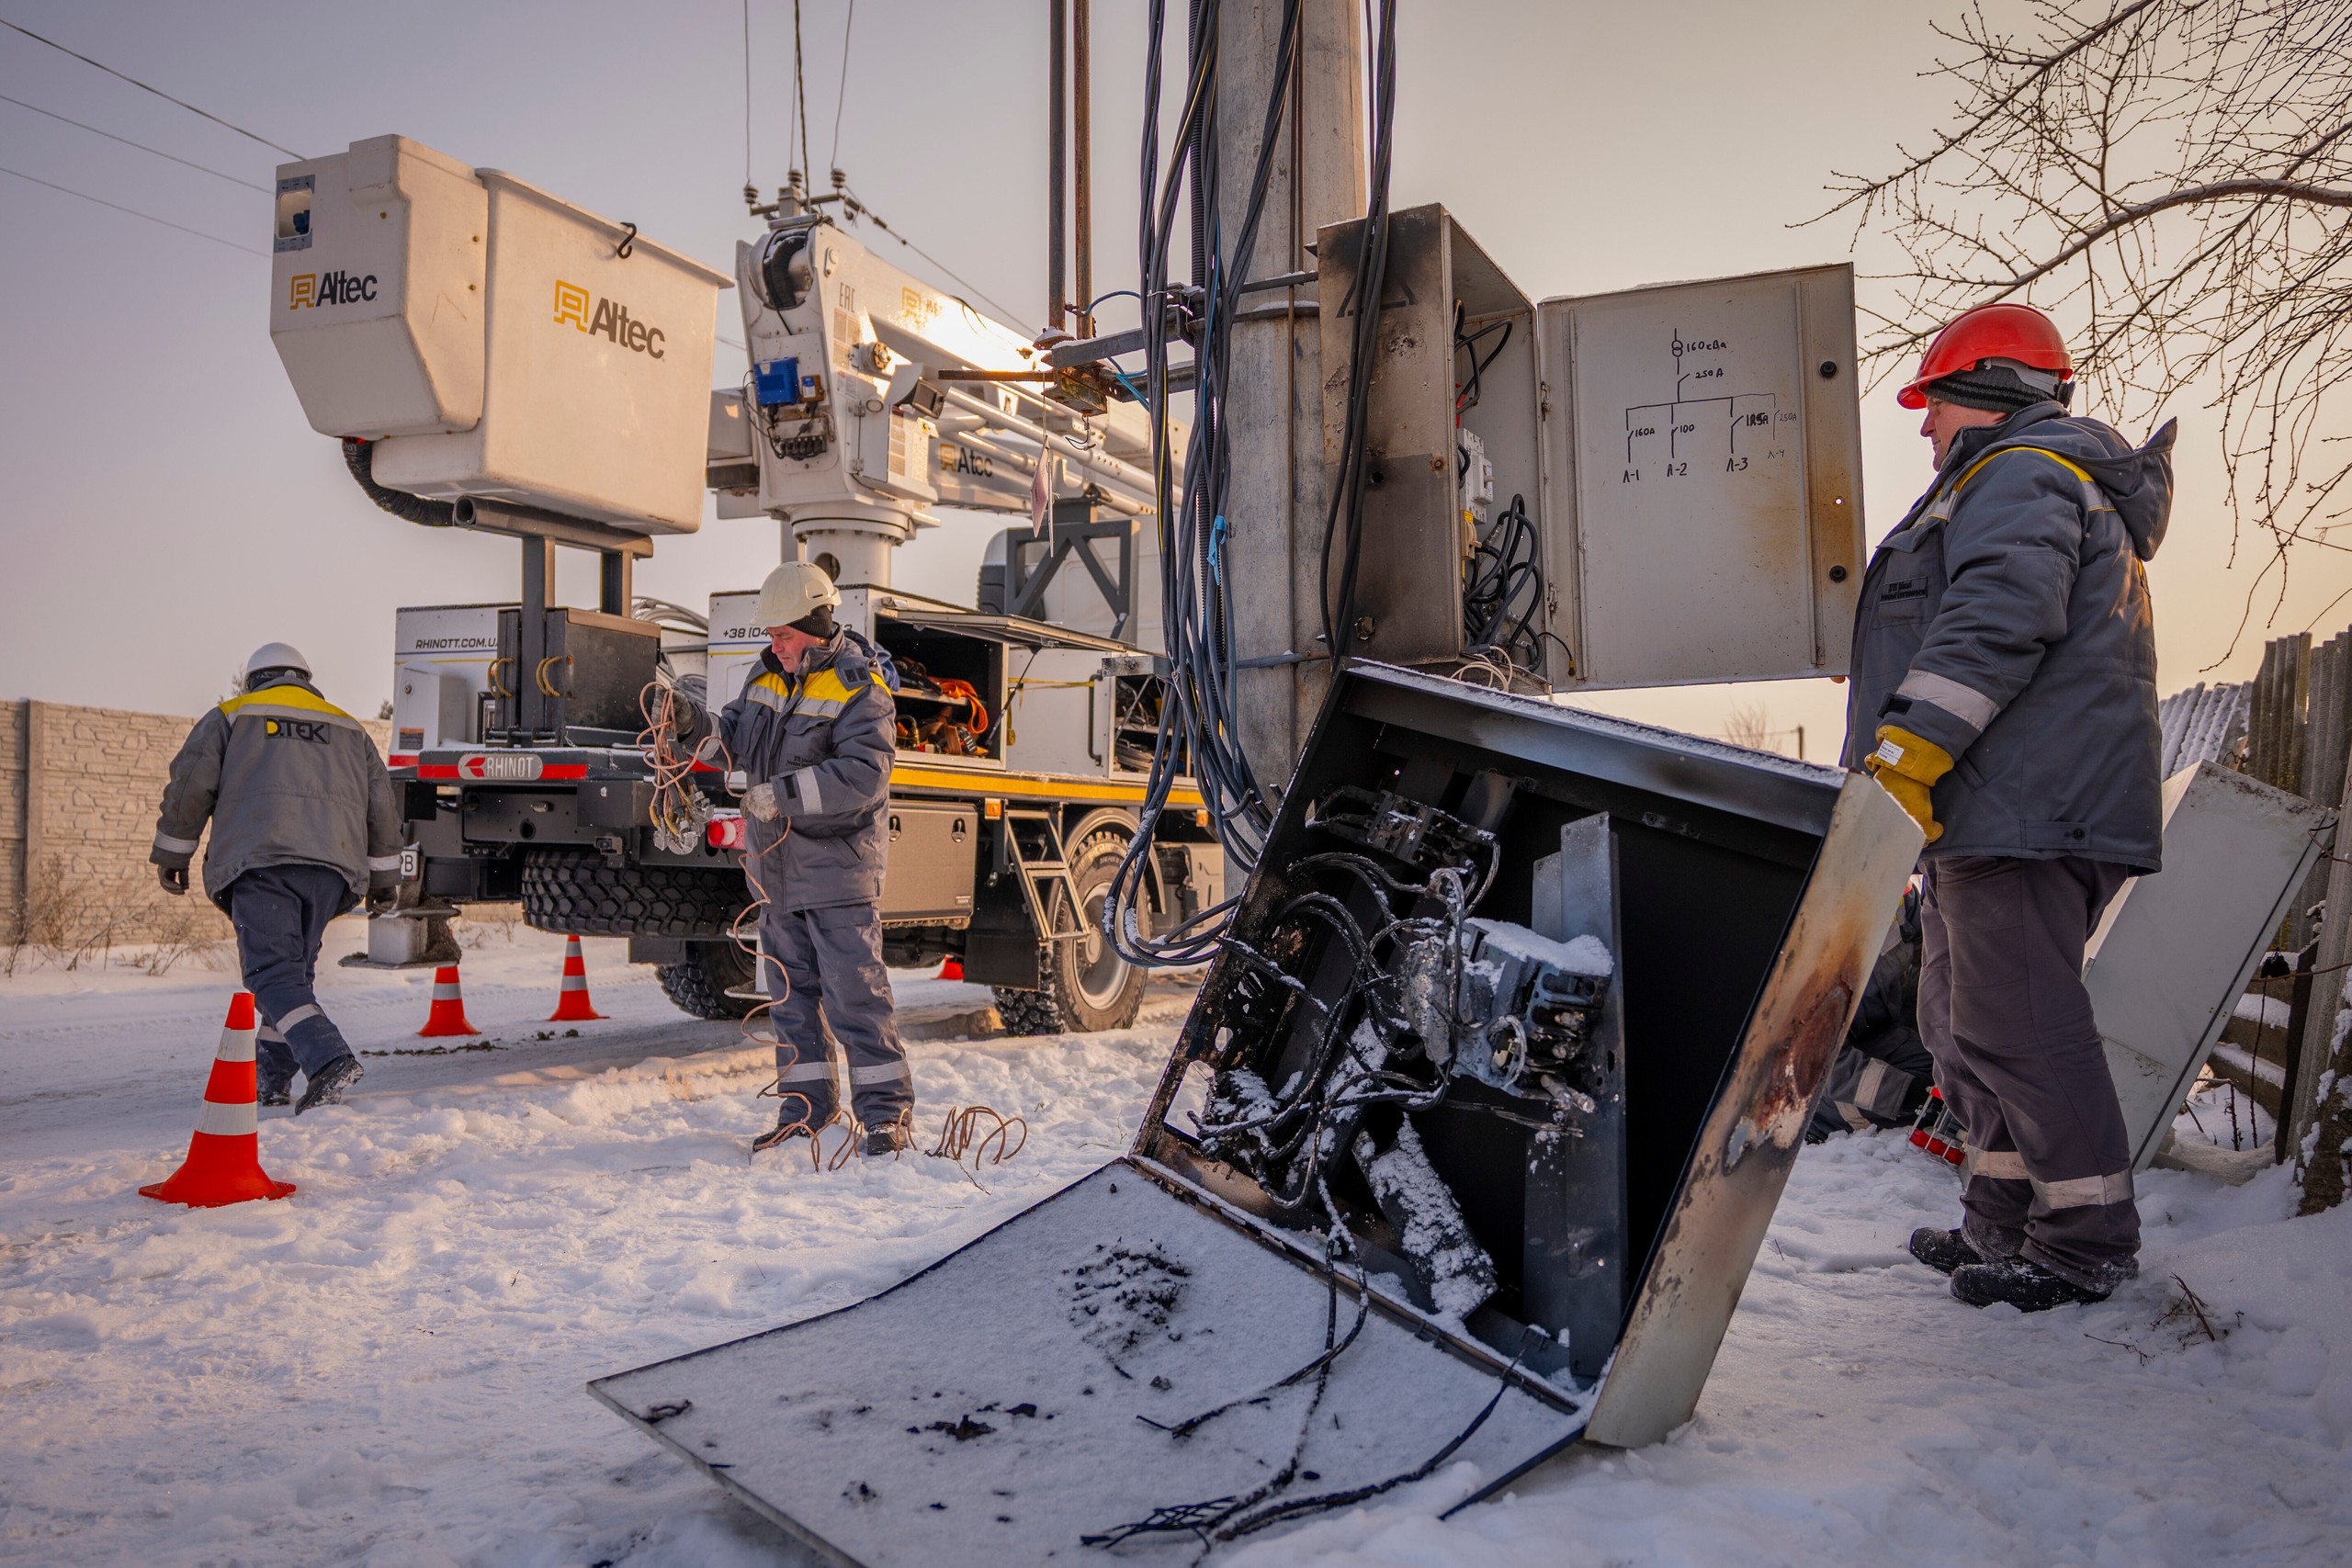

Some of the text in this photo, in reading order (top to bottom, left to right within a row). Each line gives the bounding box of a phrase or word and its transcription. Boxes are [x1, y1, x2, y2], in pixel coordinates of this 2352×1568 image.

[316, 270, 378, 308] Altec
[588, 297, 665, 359] Altec
[1679, 423, 1695, 434] 100
[723, 627, 746, 639] +38
[415, 637, 498, 649] RHINOTT.COM.U
[486, 756, 534, 778] RHINOT
